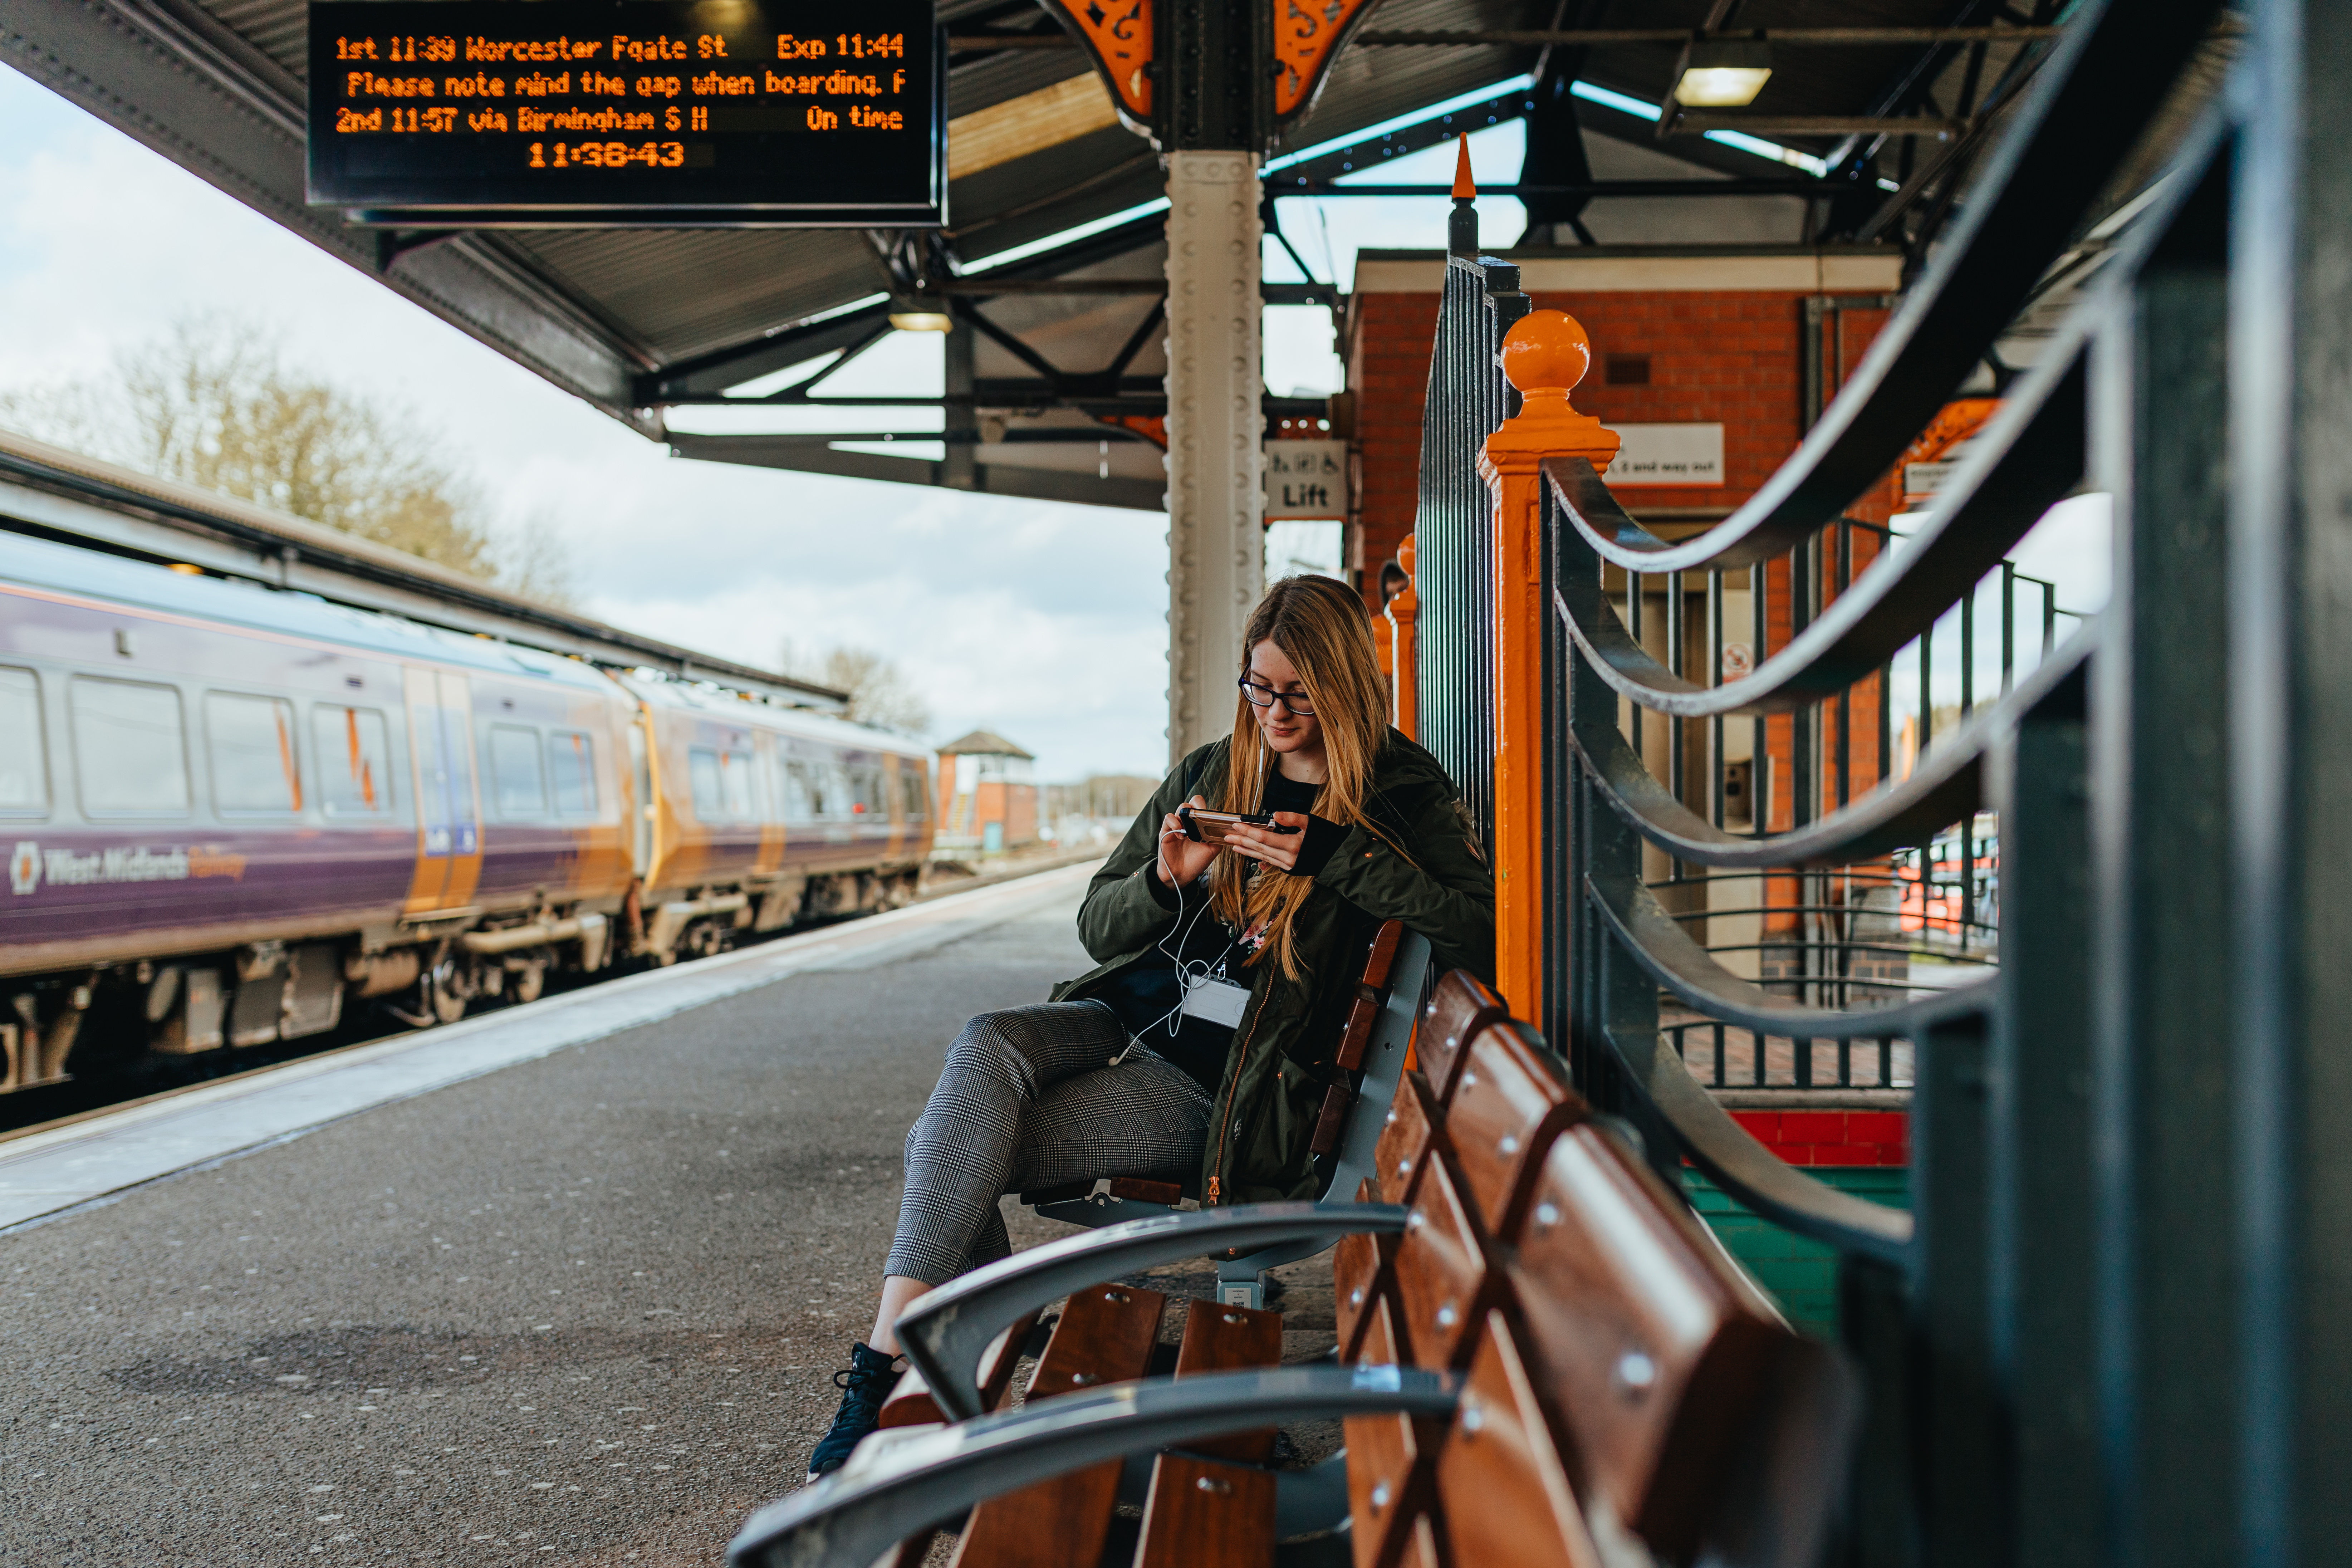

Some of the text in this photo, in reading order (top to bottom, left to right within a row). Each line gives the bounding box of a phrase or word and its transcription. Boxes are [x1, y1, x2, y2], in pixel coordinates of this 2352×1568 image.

[337, 36, 379, 60] 1st
[466, 36, 602, 62] Worcester
[697, 34, 728, 59] St
[778, 34, 826, 59] Exp
[837, 33, 903, 58] 11:44
[348, 72, 435, 97] Please
[445, 71, 505, 97] note
[515, 71, 570, 97] mind
[580, 71, 626, 96] the
[636, 76, 681, 98] gap
[692, 70, 755, 95] when
[336, 105, 903, 133] 2nd 11:57 via Birmingham S H On time
[1283, 484, 1328, 507] Lift
